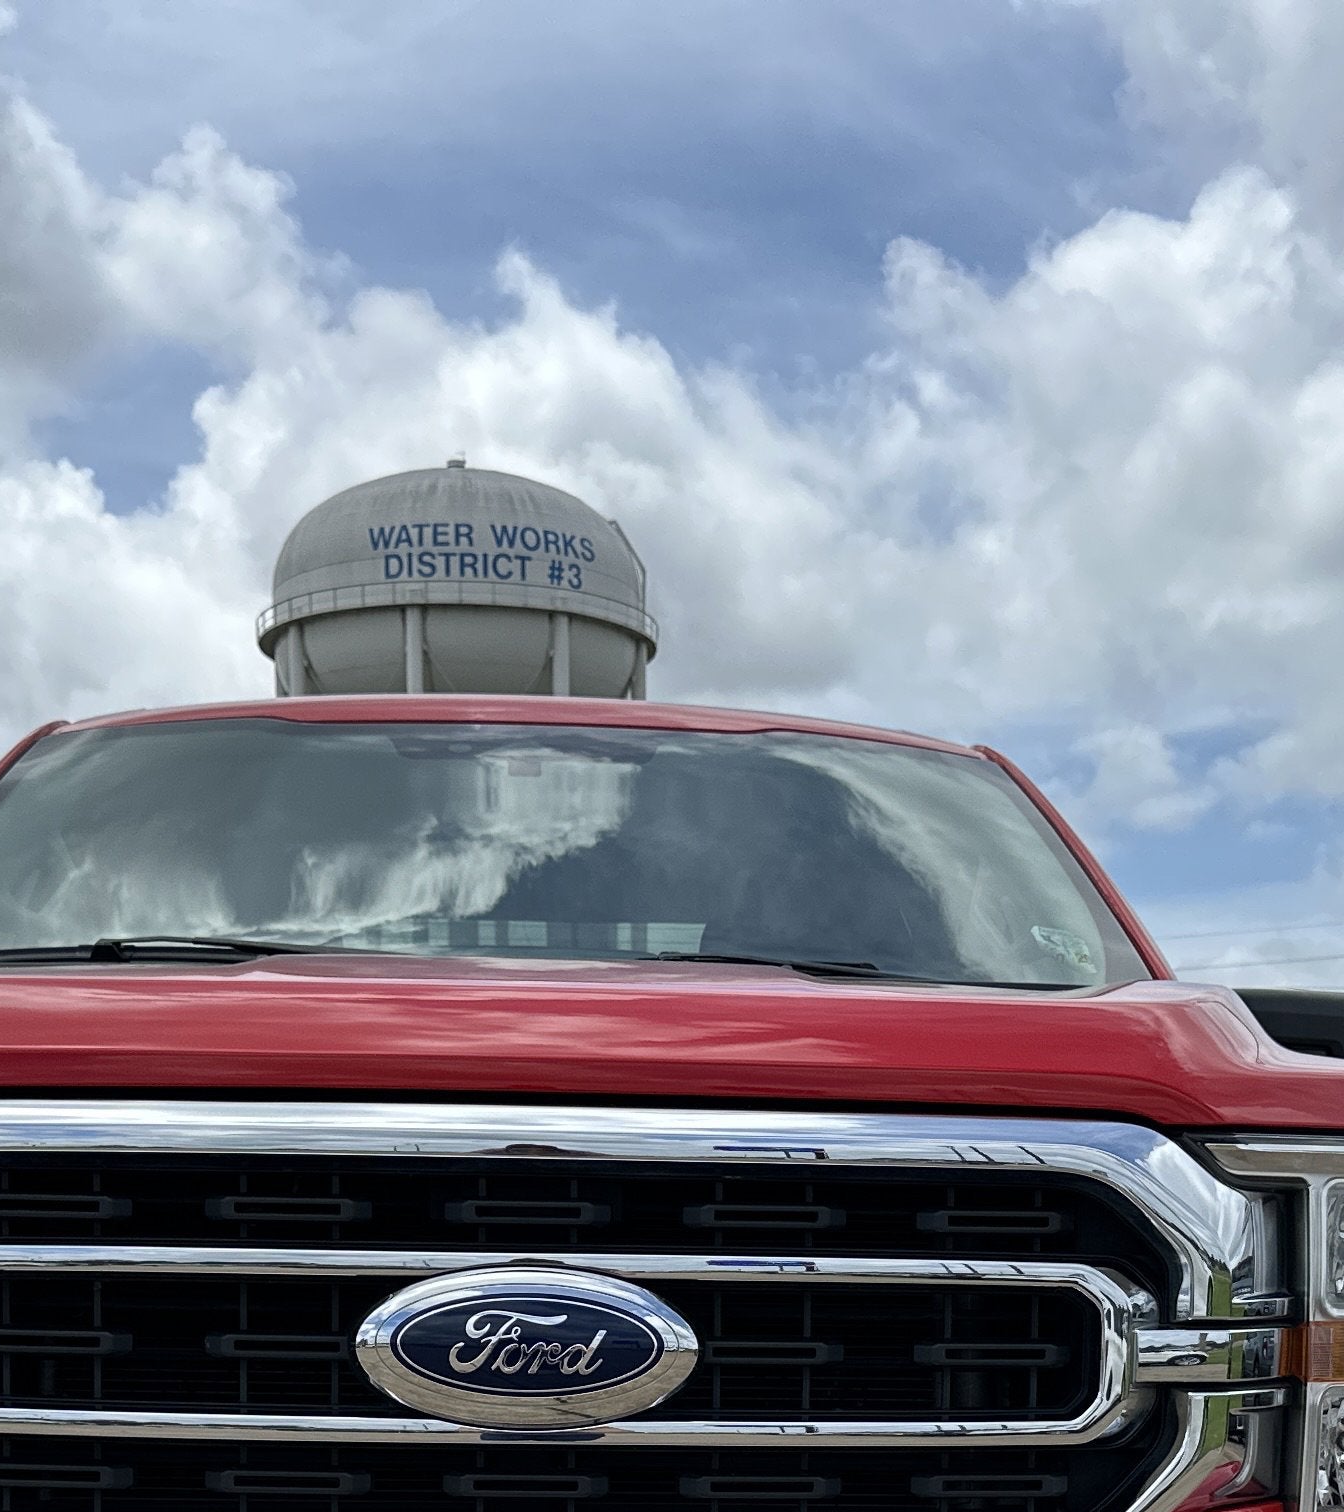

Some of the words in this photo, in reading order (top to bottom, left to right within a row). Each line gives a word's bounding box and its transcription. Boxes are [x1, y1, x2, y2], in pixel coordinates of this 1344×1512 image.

[368, 523, 474, 551] WATER
[490, 524, 596, 563] WORKS
[384, 552, 533, 582] DISTRICT
[548, 559, 582, 590] #3
[449, 1309, 607, 1376] Ford
